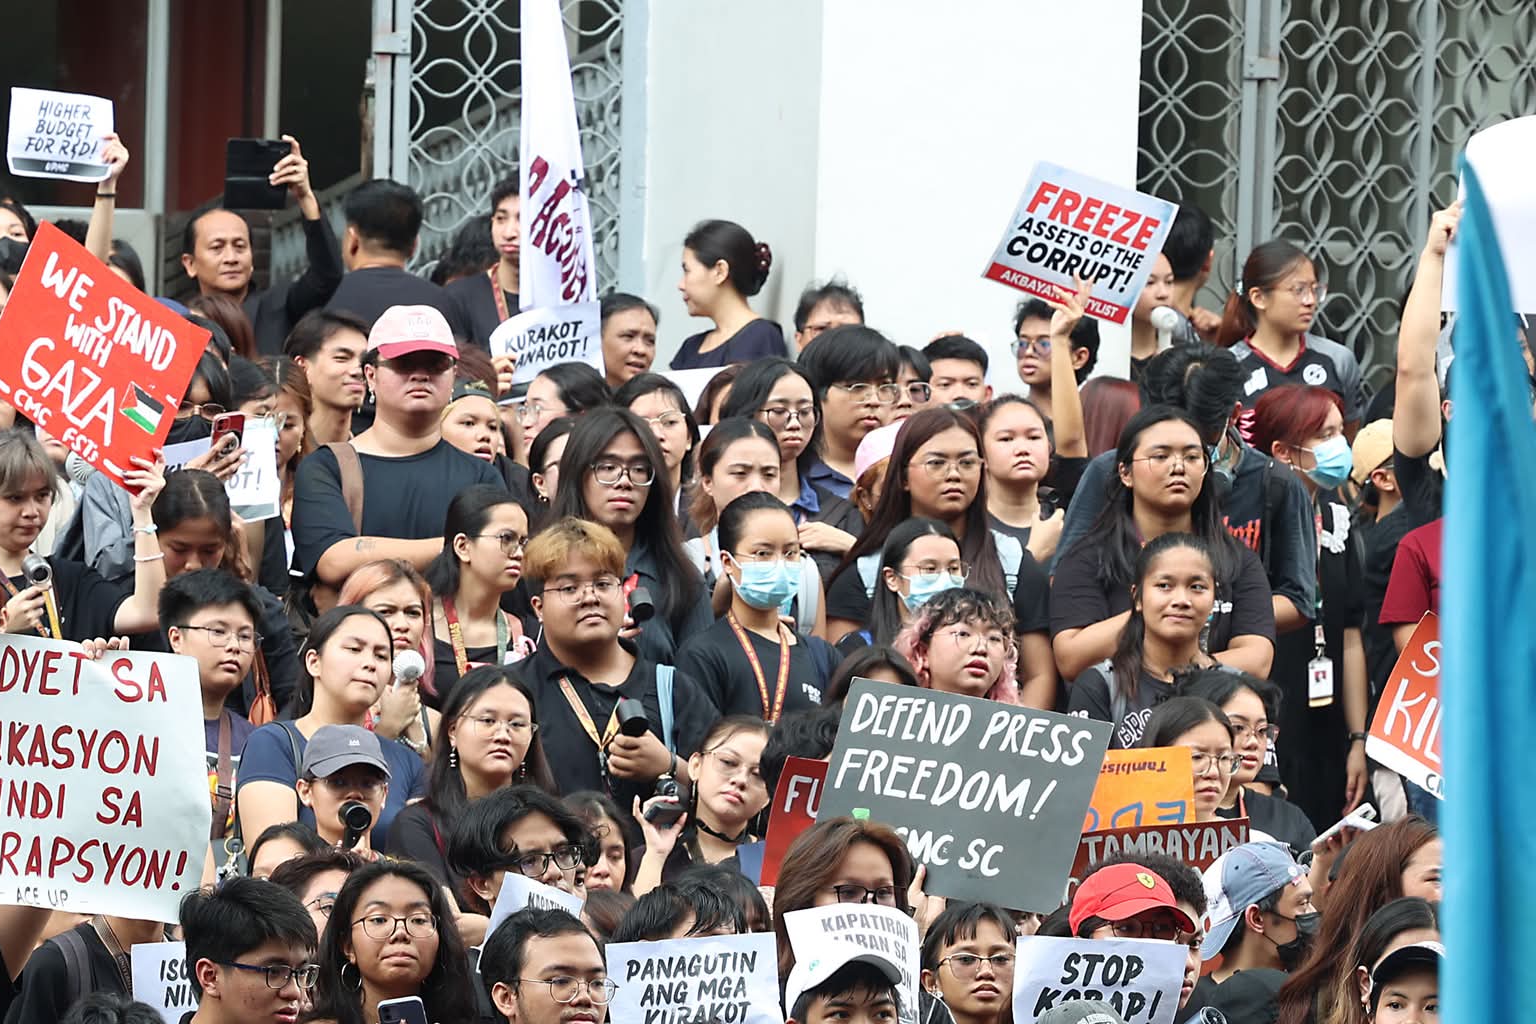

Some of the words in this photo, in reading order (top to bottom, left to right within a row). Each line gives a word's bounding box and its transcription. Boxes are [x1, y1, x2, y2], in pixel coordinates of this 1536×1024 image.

[35, 119, 95, 139] BUDGET
[38, 100, 92, 120] HIGHER
[24, 136, 55, 153] FOR
[1026, 180, 1161, 251] FREEZE
[1017, 217, 1089, 252] ASSETS
[1089, 240, 1115, 260] OF
[1112, 248, 1145, 270] THE
[40, 251, 94, 312] WE
[1006, 235, 1135, 294] CORRUPT!
[64, 315, 114, 369] WITH
[94, 296, 177, 371] STAND
[504, 319, 583, 355] KURAKOT
[513, 336, 589, 370] ANAGOT!
[13, 389, 53, 427] CMC
[20, 336, 116, 447] GAZA
[111, 657, 168, 703] SA
[849, 692, 973, 748] DEFEND
[978, 710, 1093, 767] PRESS
[833, 747, 1058, 820] FREEDOM!
[96, 786, 143, 828] SA
[958, 838, 1005, 878] SC
[820, 912, 911, 944] KAPATIRAN
[626, 950, 758, 982] PANAGUTIN
[1060, 951, 1145, 988] STOP
[640, 982, 689, 1008] ANG
[697, 977, 747, 1001] MGA
